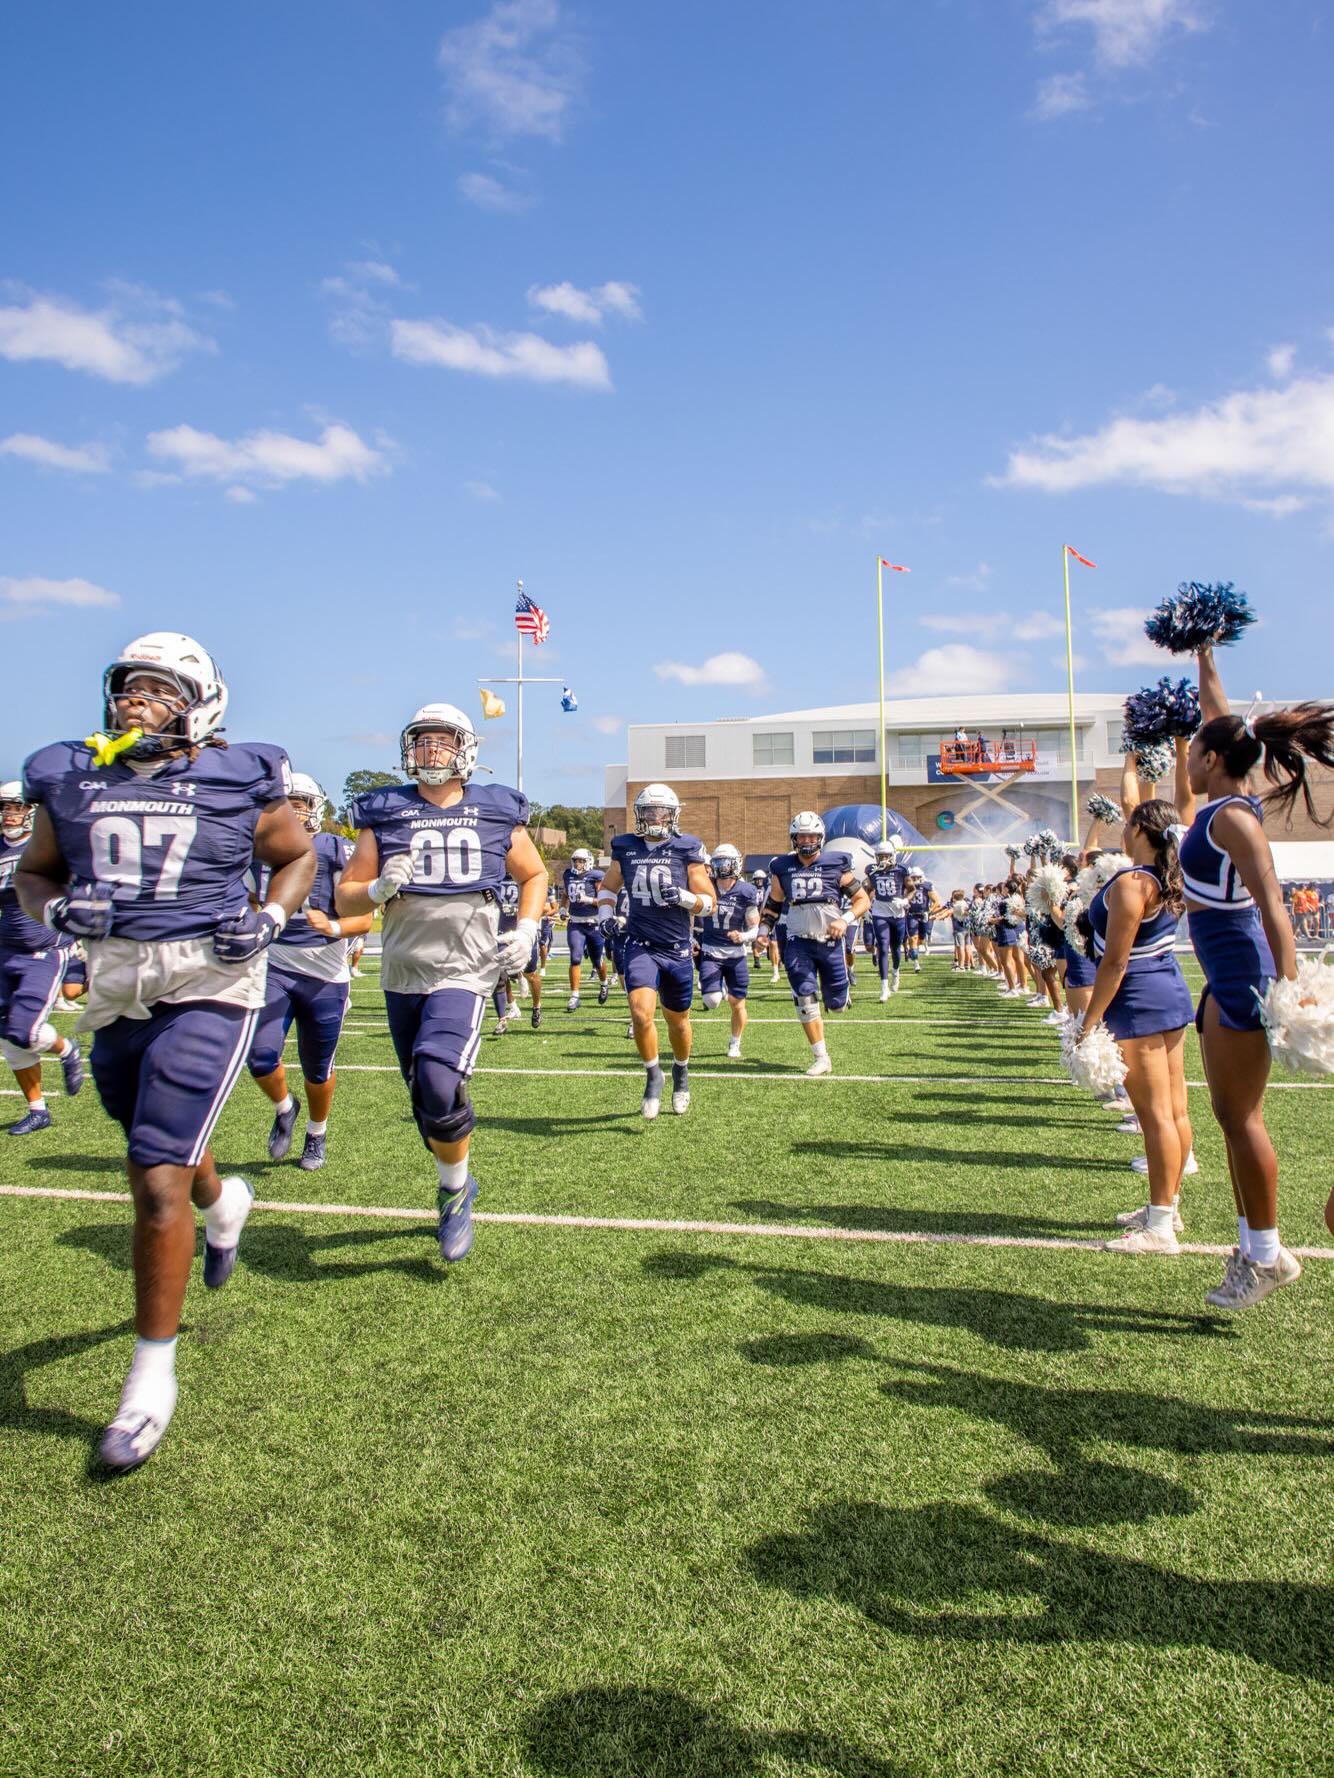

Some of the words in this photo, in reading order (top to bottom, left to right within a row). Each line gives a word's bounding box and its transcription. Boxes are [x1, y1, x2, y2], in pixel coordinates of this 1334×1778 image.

[89, 800, 195, 815] MONMOUTH
[401, 809, 419, 817] CAA
[410, 817, 478, 829] MONMOUTH
[89, 816, 198, 900] 97
[410, 827, 482, 885] 60
[631, 865, 672, 906] 40
[791, 878, 824, 899] 62
